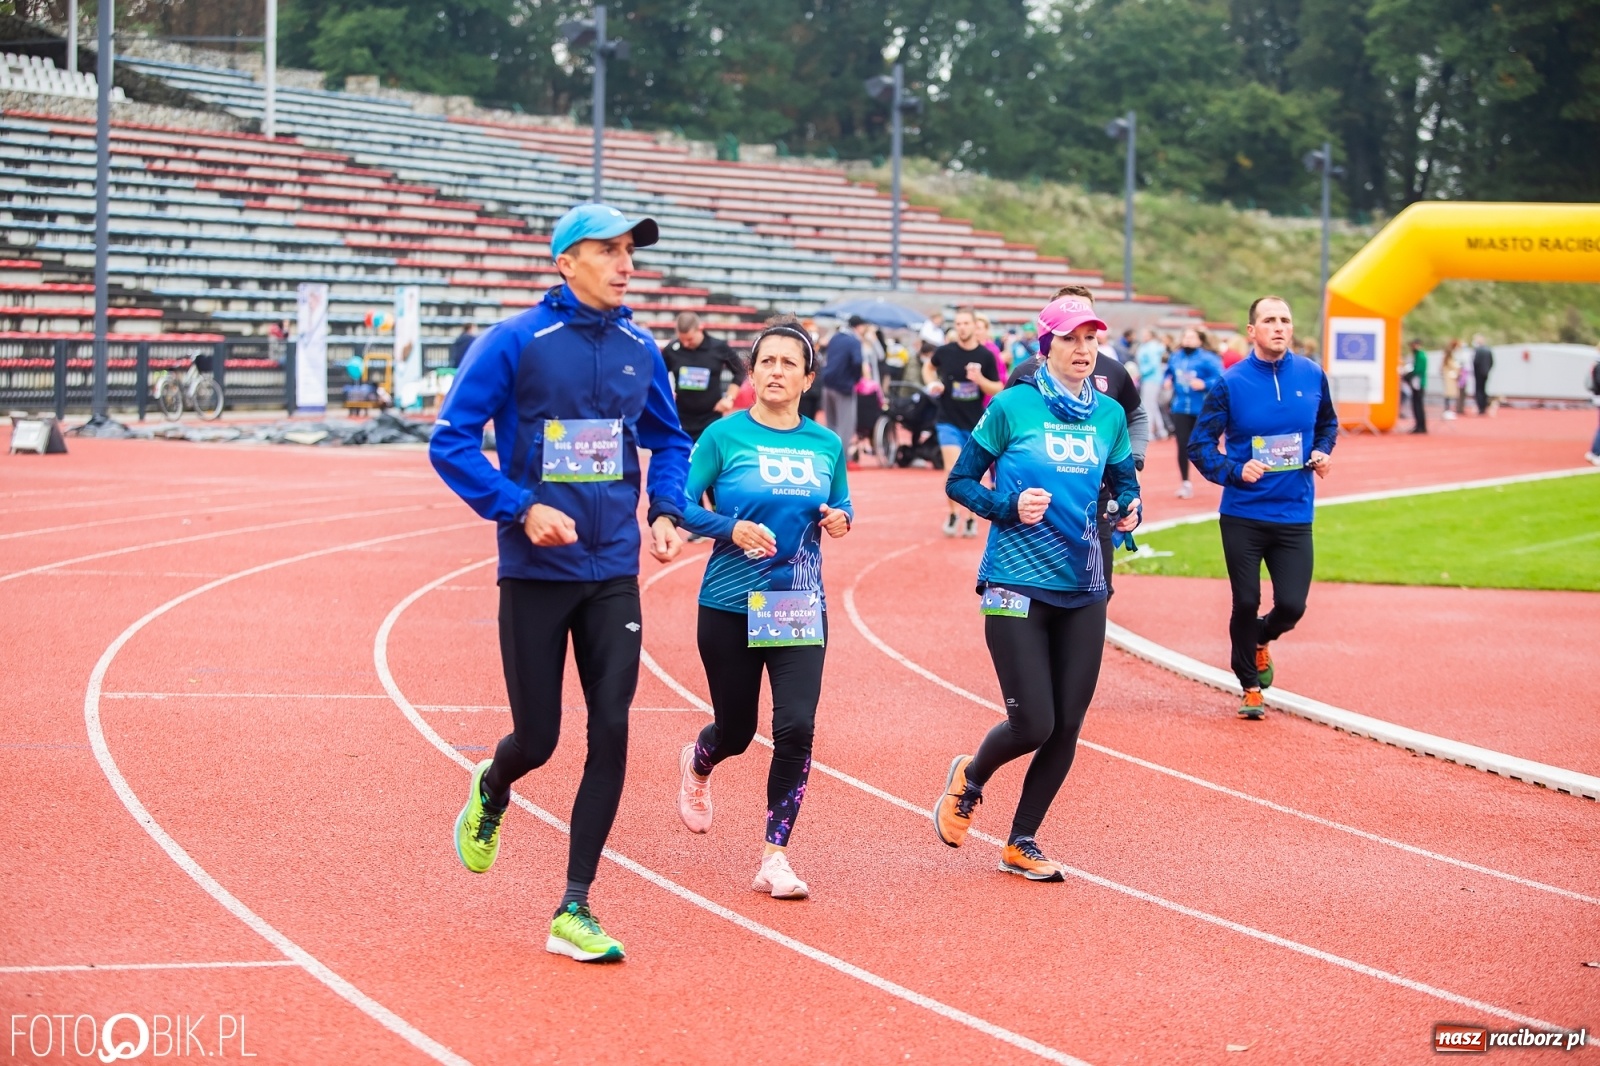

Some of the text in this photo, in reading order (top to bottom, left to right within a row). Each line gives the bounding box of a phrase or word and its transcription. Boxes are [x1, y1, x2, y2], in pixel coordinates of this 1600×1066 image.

[1466, 236, 1533, 252] MIASTO
[1043, 421, 1097, 433] BiegamBoLubię
[574, 441, 590, 450] DLA
[1044, 432, 1099, 465] bbl
[592, 460, 617, 475] 039
[758, 454, 821, 487] bbl
[1056, 465, 1089, 475] RACIBÓRZ
[772, 487, 811, 497] RACIBÓRZ
[1000, 598, 1023, 610] 230
[757, 610, 771, 618] BIEG
[774, 610, 787, 618] DLA
[791, 627, 816, 638] 014
